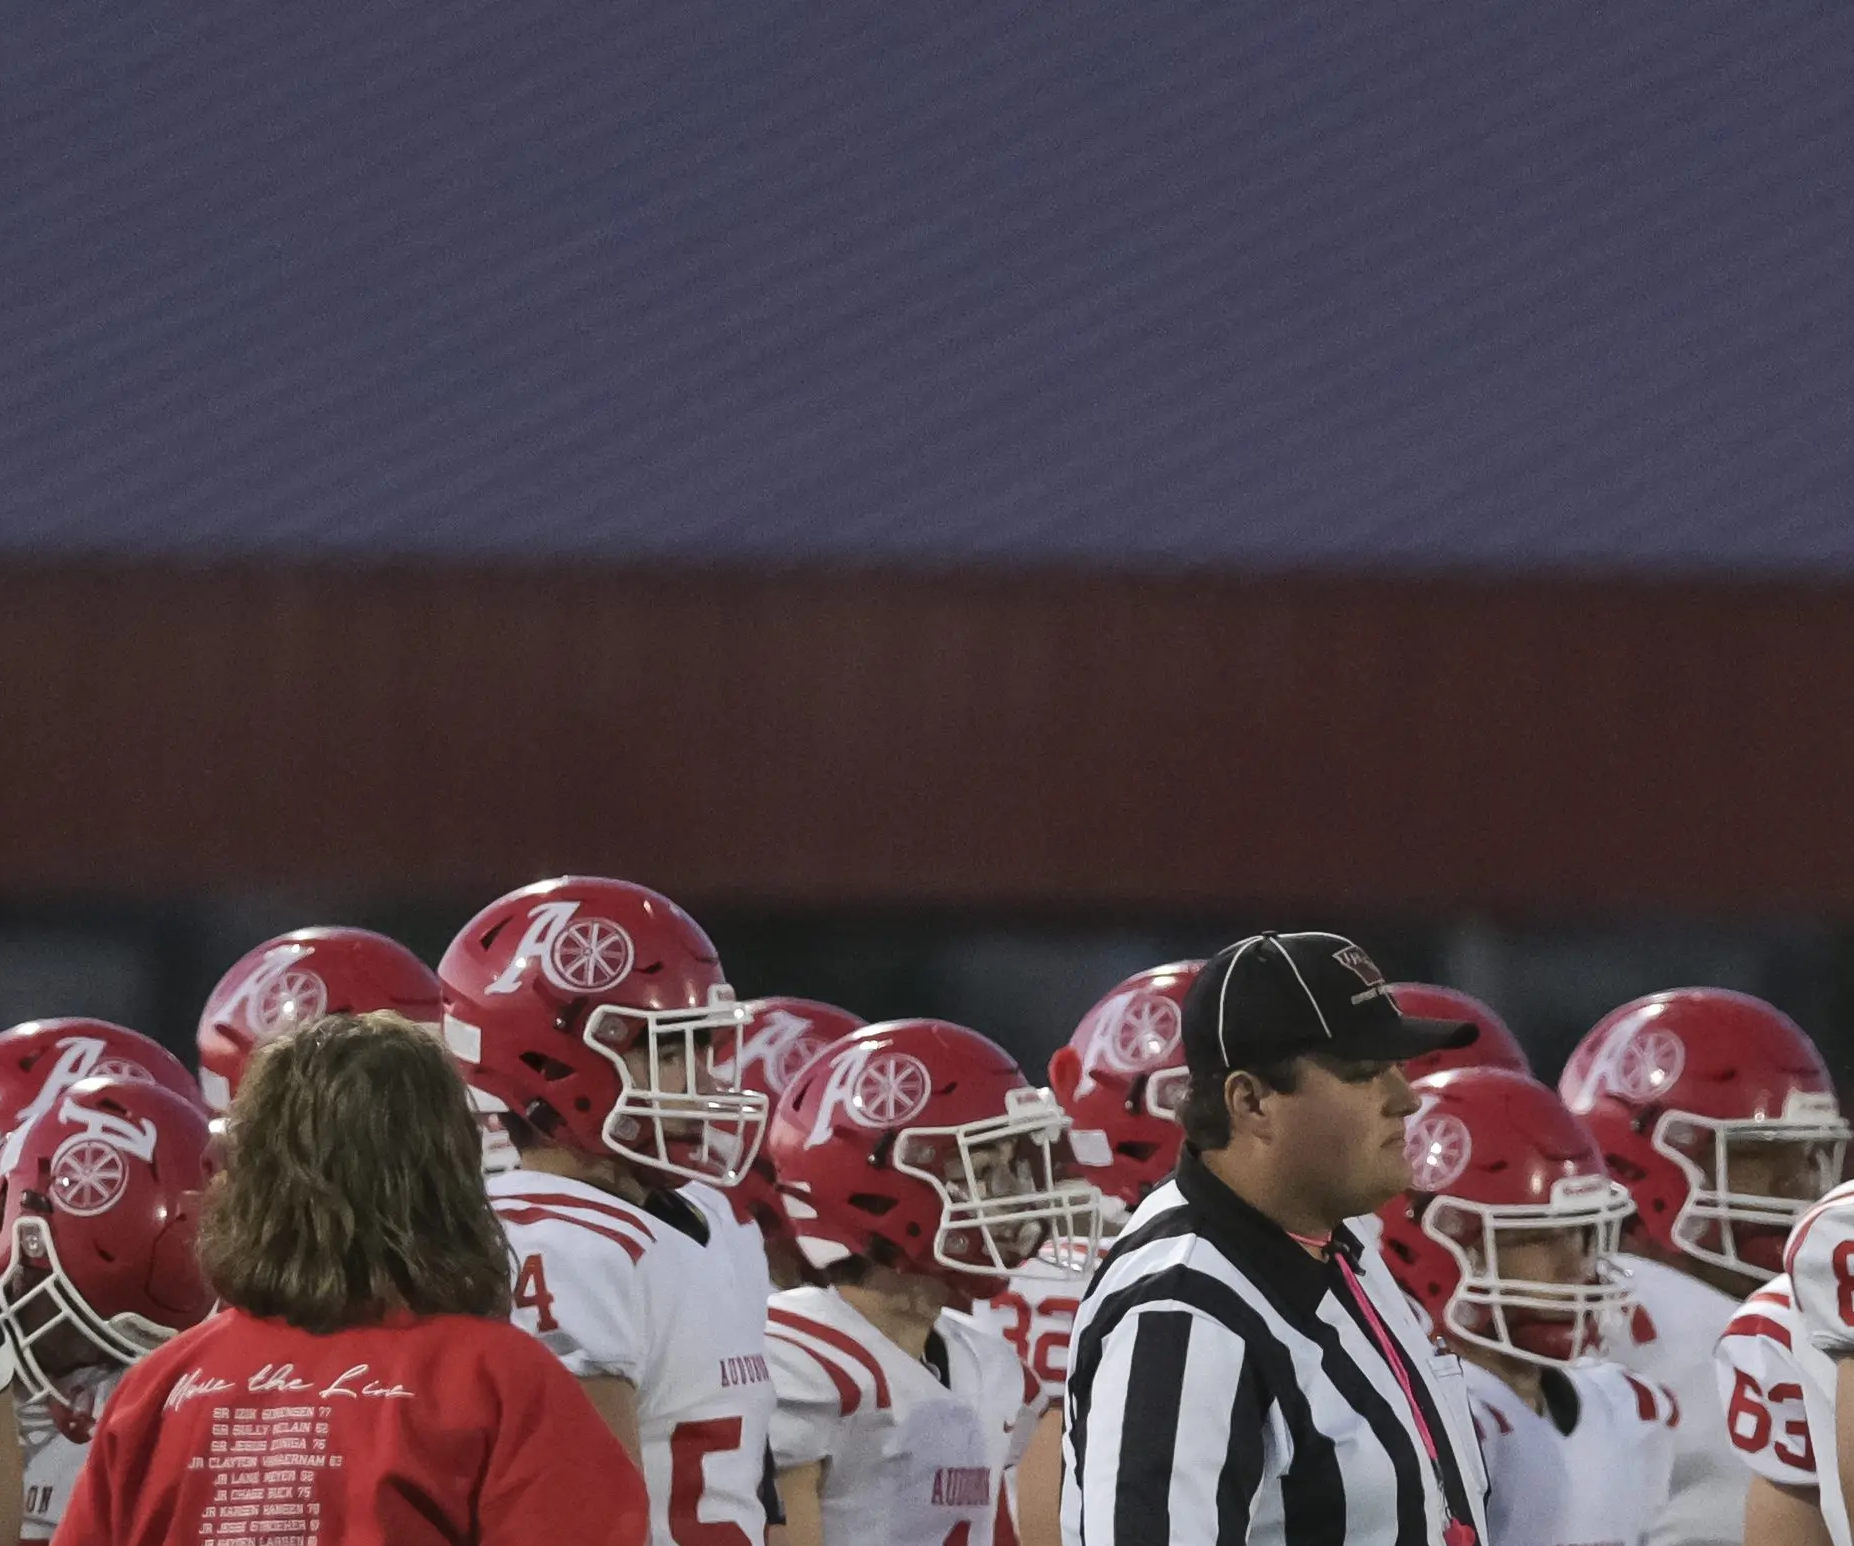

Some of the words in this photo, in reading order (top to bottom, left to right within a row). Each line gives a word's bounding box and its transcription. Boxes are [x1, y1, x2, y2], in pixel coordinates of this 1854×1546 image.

[248, 1363, 314, 1392] the
[319, 1364, 415, 1399] Line
[212, 1407, 230, 1419] SR
[318, 1406, 331, 1418] 77
[1727, 1368, 1816, 1471] 63
